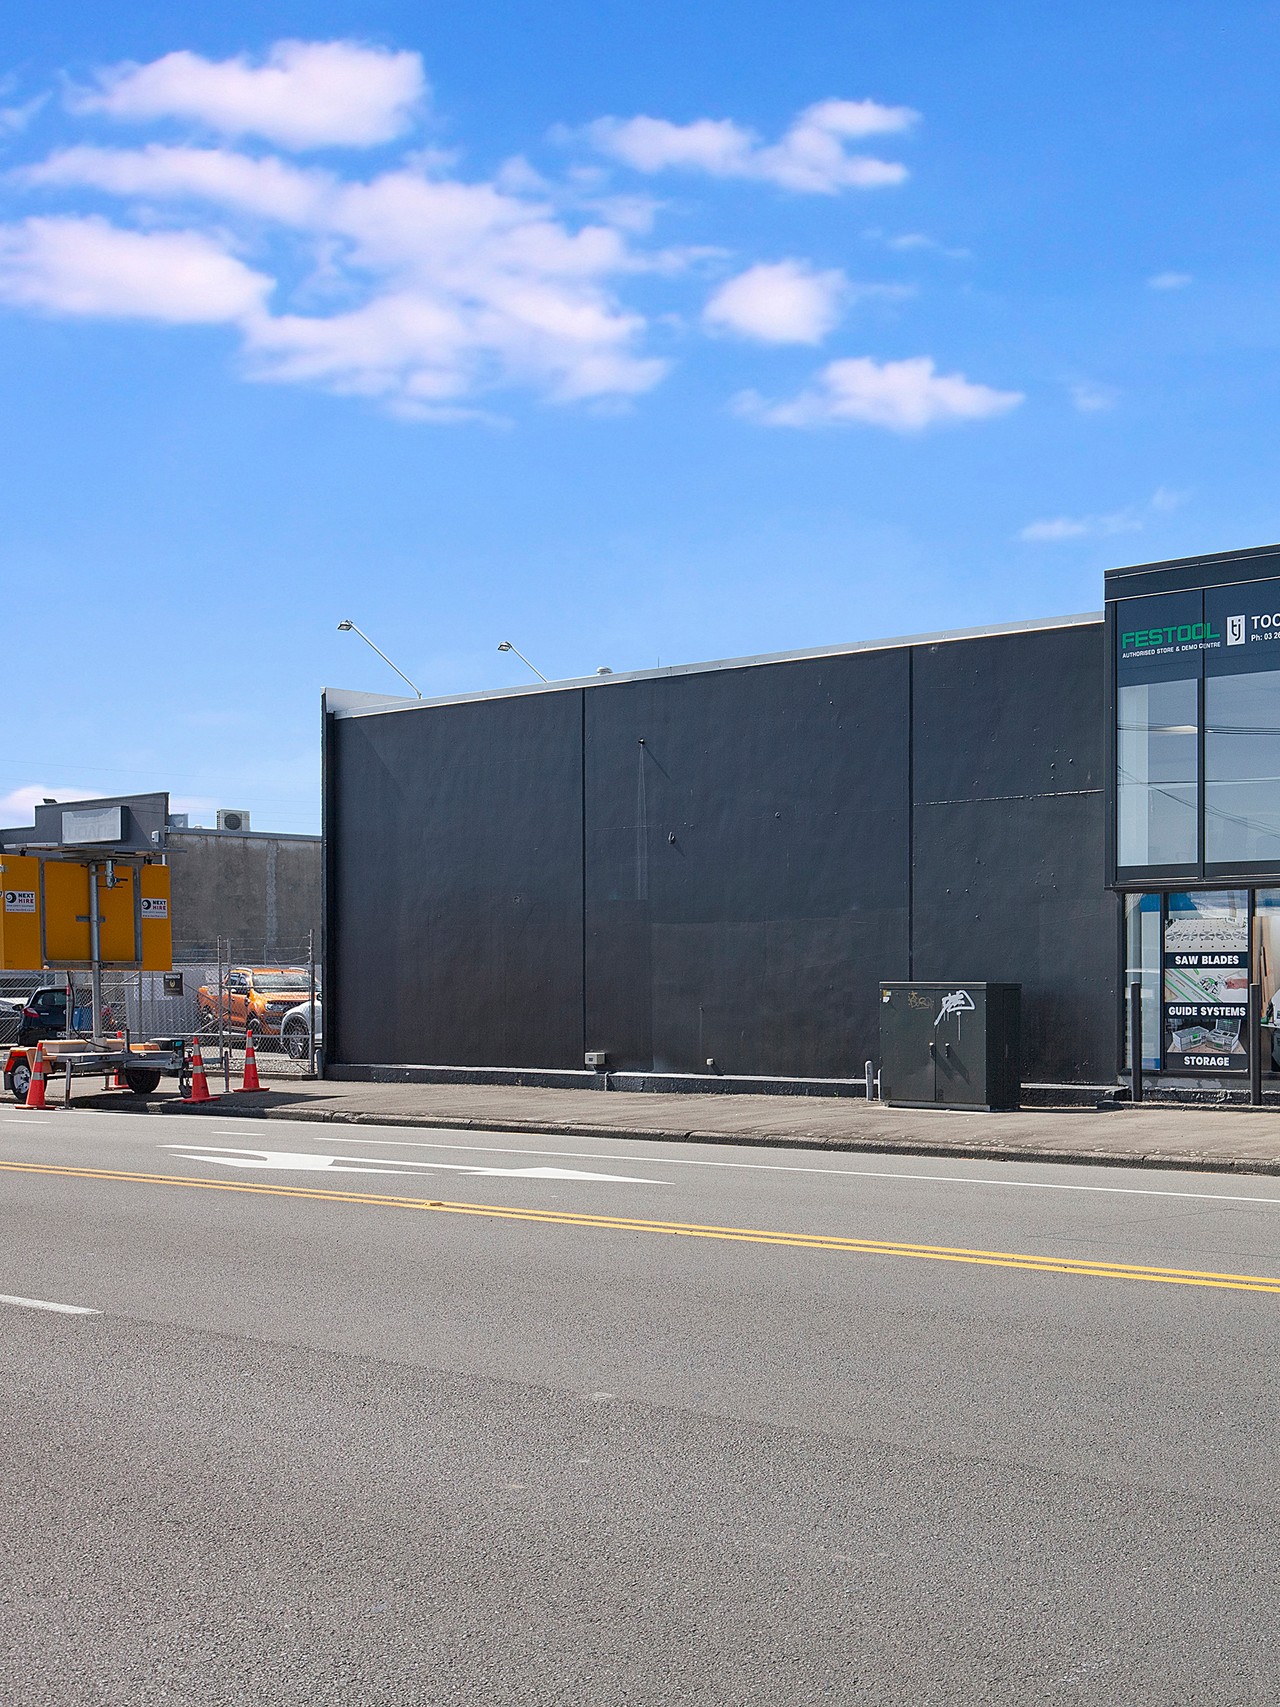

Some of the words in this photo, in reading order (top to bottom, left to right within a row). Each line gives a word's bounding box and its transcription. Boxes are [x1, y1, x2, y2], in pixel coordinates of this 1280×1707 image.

[1122, 623, 1220, 649] FESTOOL
[1251, 634, 1263, 642] Ph:
[1122, 649, 1156, 659] AUTHORISED
[1156, 647, 1174, 655] STORE
[1181, 643, 1197, 651] DEMO
[1175, 955, 1199, 965] SAW
[1201, 955, 1240, 965] BLADES
[1168, 1006, 1198, 1016] GUIDE
[1200, 1006, 1246, 1016] SYSTEMS
[1183, 1056, 1230, 1067] STORAGE
